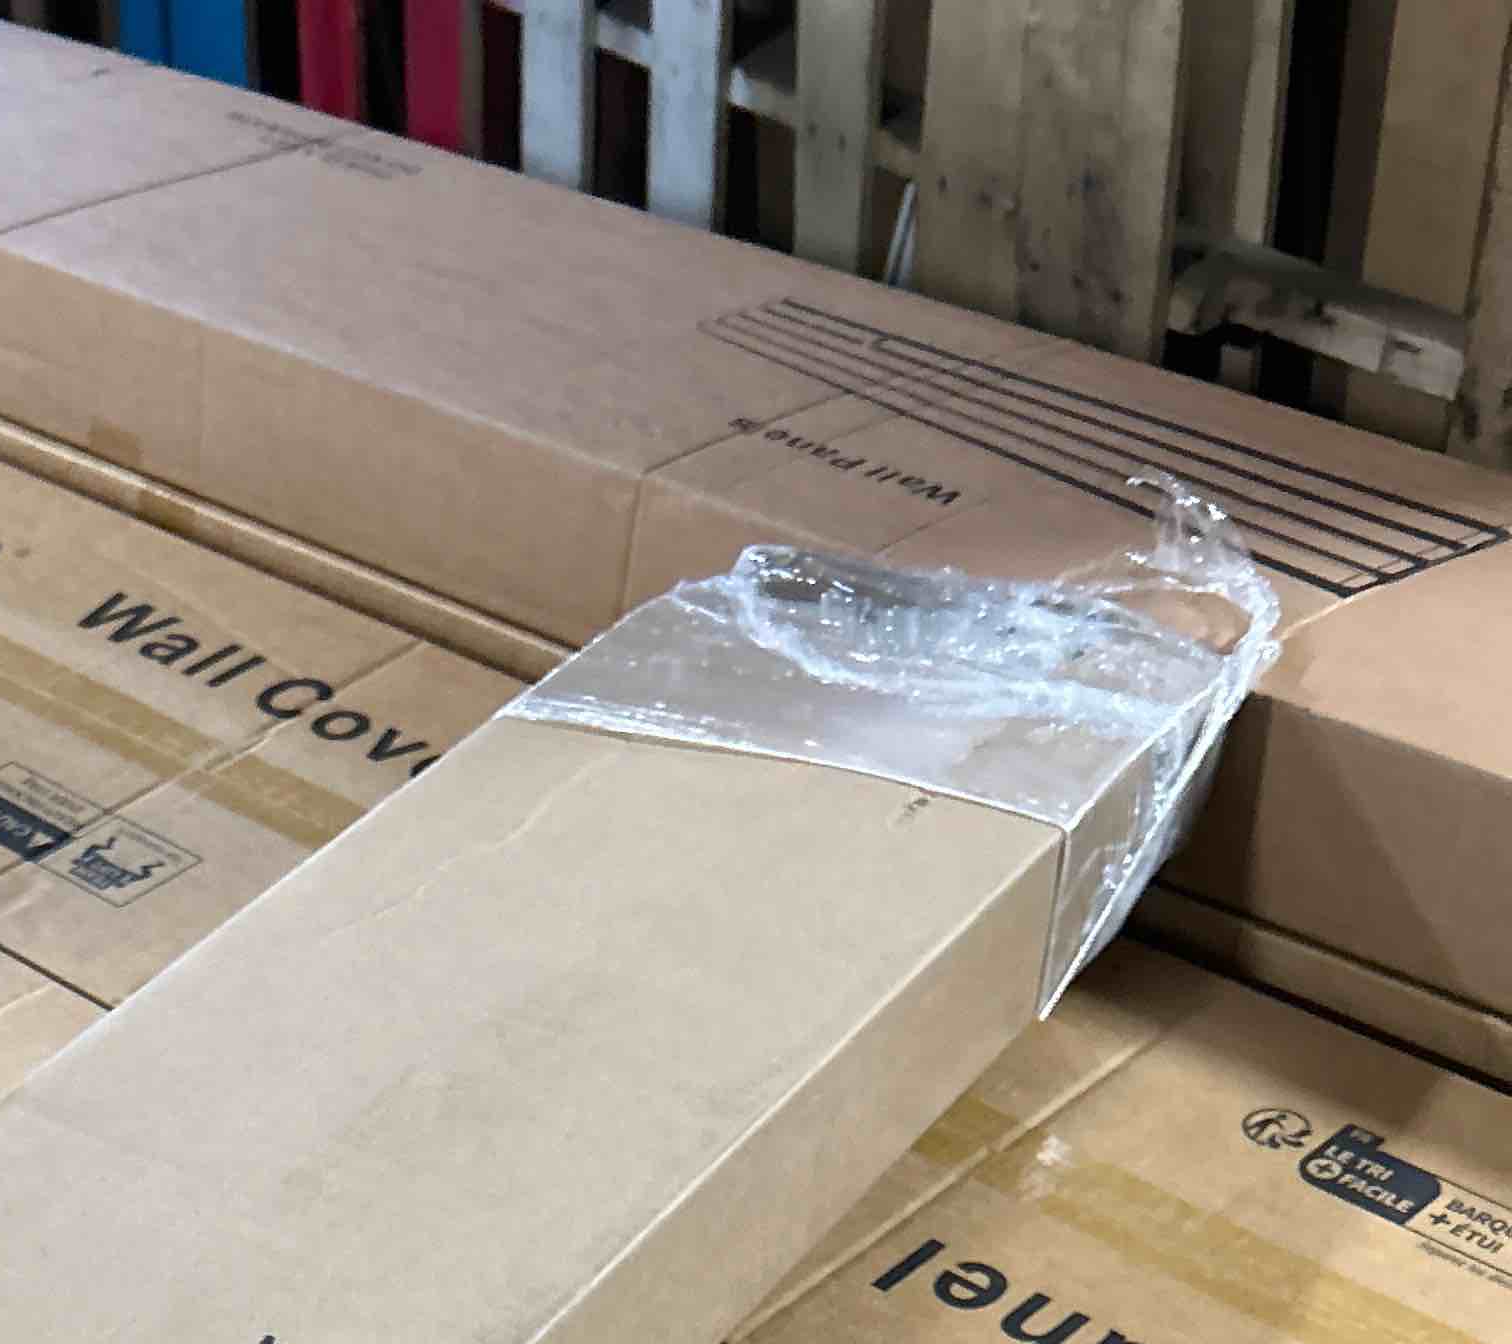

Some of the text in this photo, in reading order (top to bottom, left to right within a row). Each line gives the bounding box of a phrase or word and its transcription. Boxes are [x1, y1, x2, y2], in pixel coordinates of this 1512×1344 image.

[76, 591, 442, 780] Wall Cov
[1356, 1158, 1395, 1182] TRI
[1338, 1174, 1415, 1214] FACILE
